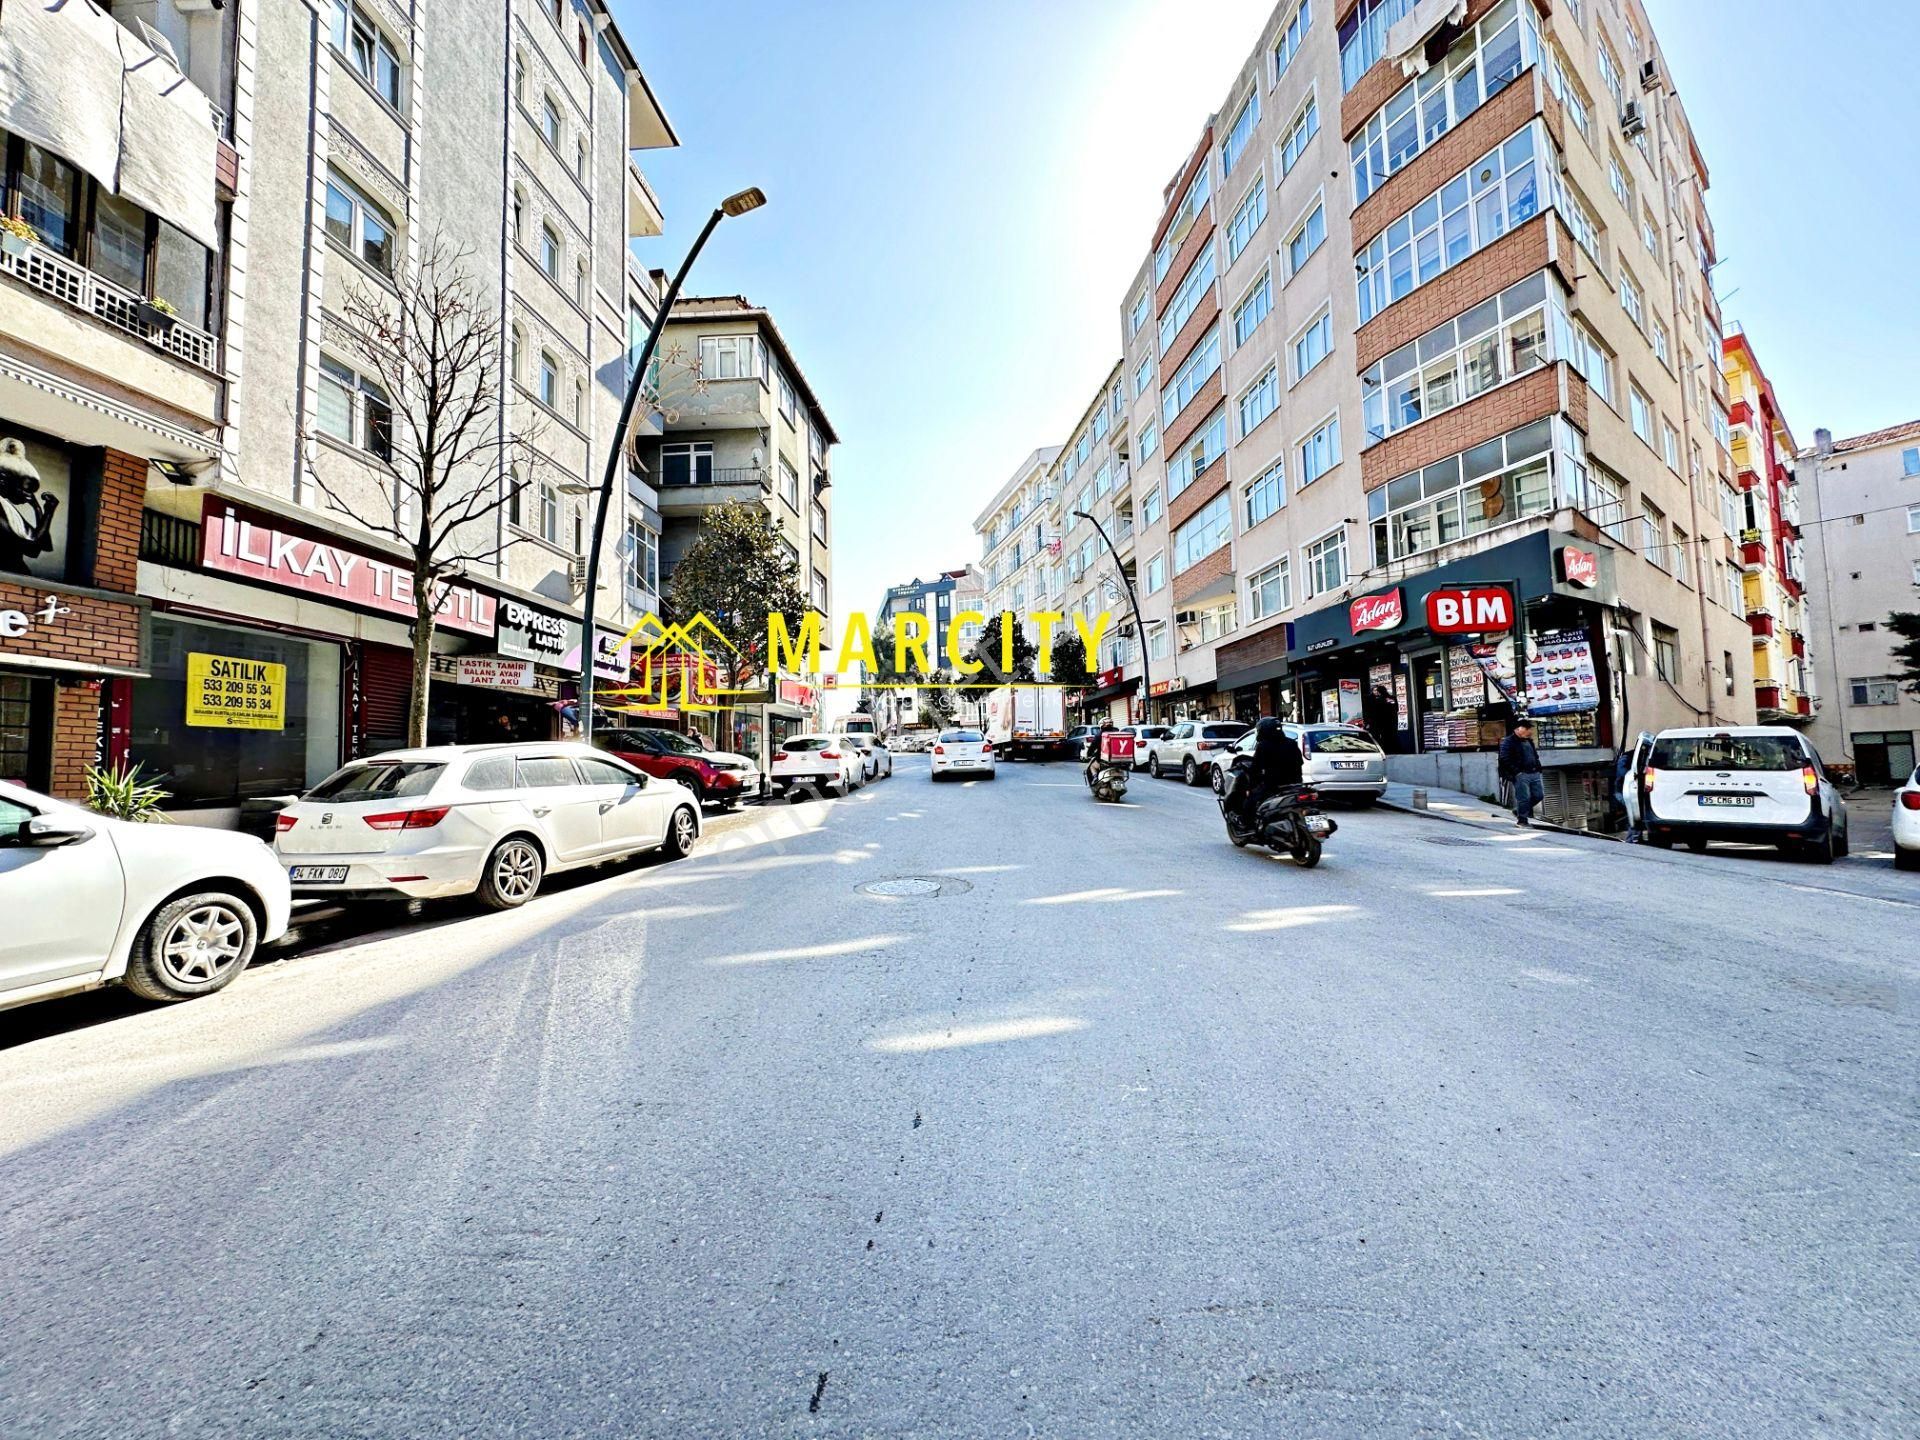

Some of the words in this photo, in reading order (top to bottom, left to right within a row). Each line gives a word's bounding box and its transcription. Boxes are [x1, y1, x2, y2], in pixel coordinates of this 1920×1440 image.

[222, 507, 360, 588] İLKAY
[367, 560, 492, 628] TESTİL
[1436, 590, 1507, 627] BİM
[507, 602, 569, 638] EXPRESS
[535, 633, 568, 651] LASTİK
[211, 659, 266, 682] SATILIK
[459, 659, 492, 669] LASTİK
[497, 661, 527, 671] TAMİRİ
[464, 668, 496, 677] BALANS
[500, 670, 521, 678] AYARI
[203, 678, 222, 692] 533
[226, 680, 244, 694] 209
[246, 683, 258, 696] 55
[260, 684, 272, 696] 34
[470, 676, 493, 684] JANT
[203, 694, 222, 707] 533
[225, 695, 243, 709] 209
[246, 697, 257, 709] 55
[260, 698, 272, 711] 34
[1704, 796, 1713, 804] 35
[1717, 796, 1733, 804] CMG
[1736, 797, 1752, 805] 810
[293, 867, 304, 880] 34
[307, 866, 326, 879] FKN
[328, 866, 346, 880] 080
